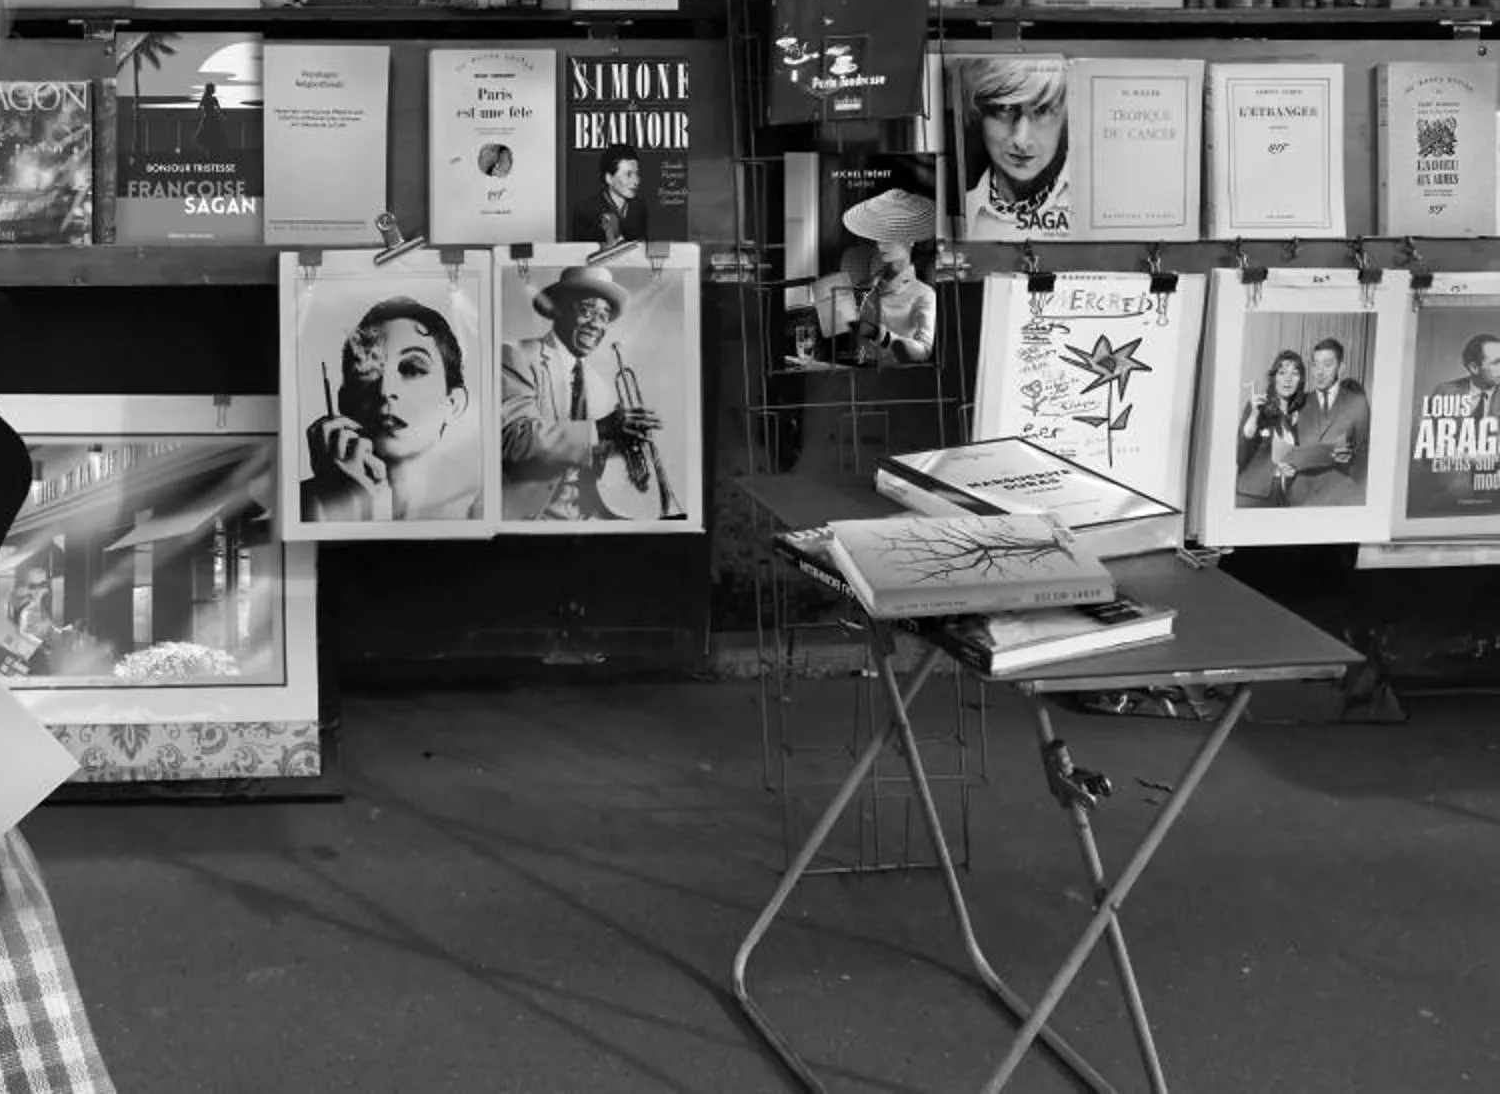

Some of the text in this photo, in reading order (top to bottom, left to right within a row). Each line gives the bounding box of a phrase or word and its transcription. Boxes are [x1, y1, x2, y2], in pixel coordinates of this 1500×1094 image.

[573, 62, 690, 101] SIMONE
[574, 111, 690, 149] BEAUVOIR
[184, 196, 257, 216] SAGAN
[1422, 394, 1473, 418] LOUIS
[1413, 416, 1500, 460] ARAG
